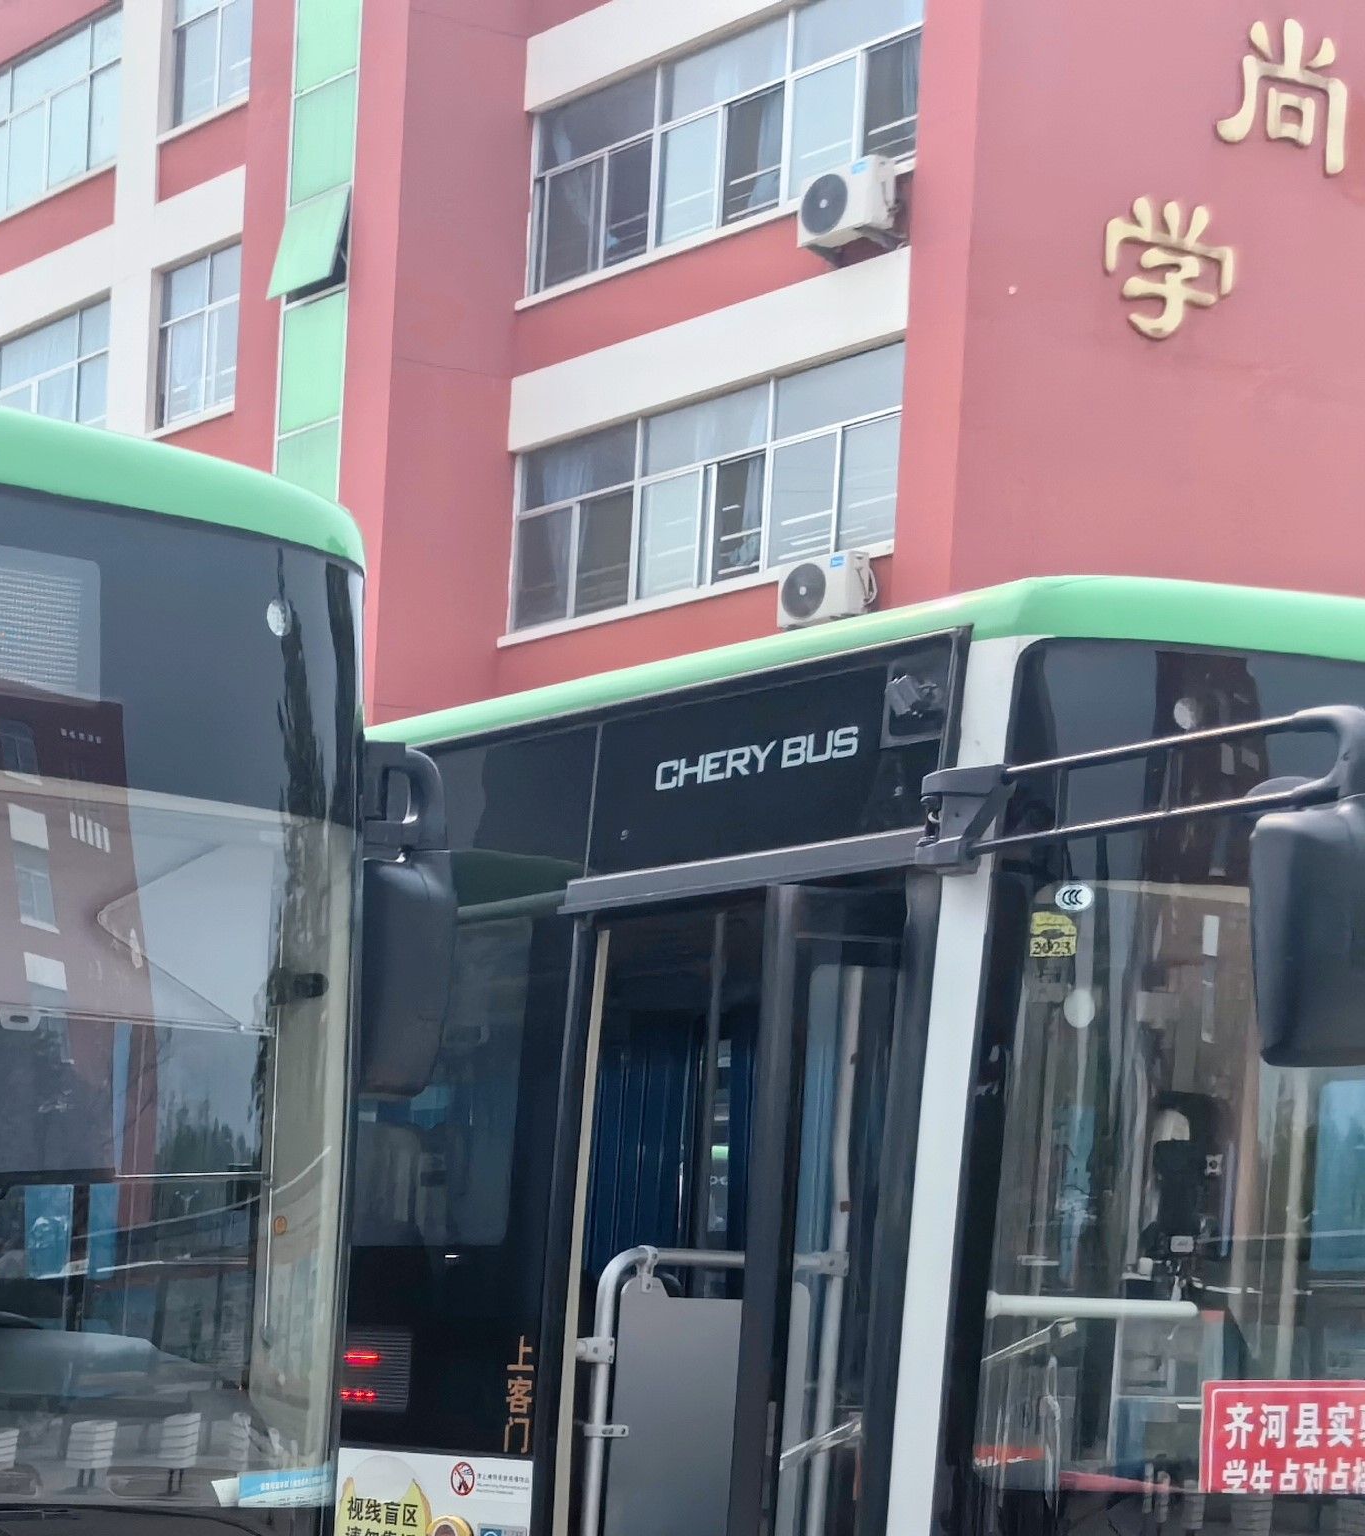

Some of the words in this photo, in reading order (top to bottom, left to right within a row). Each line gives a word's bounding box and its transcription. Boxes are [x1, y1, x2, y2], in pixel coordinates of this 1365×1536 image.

[1218, 18, 1348, 174] 尚
[1106, 196, 1235, 340] 学
[655, 740, 777, 791] CHERY
[780, 726, 859, 769] BUS
[503, 1335, 535, 1454] 上客门
[1223, 1402, 1365, 1450] 齐河县实
[347, 1496, 418, 1527] 视线盲区
